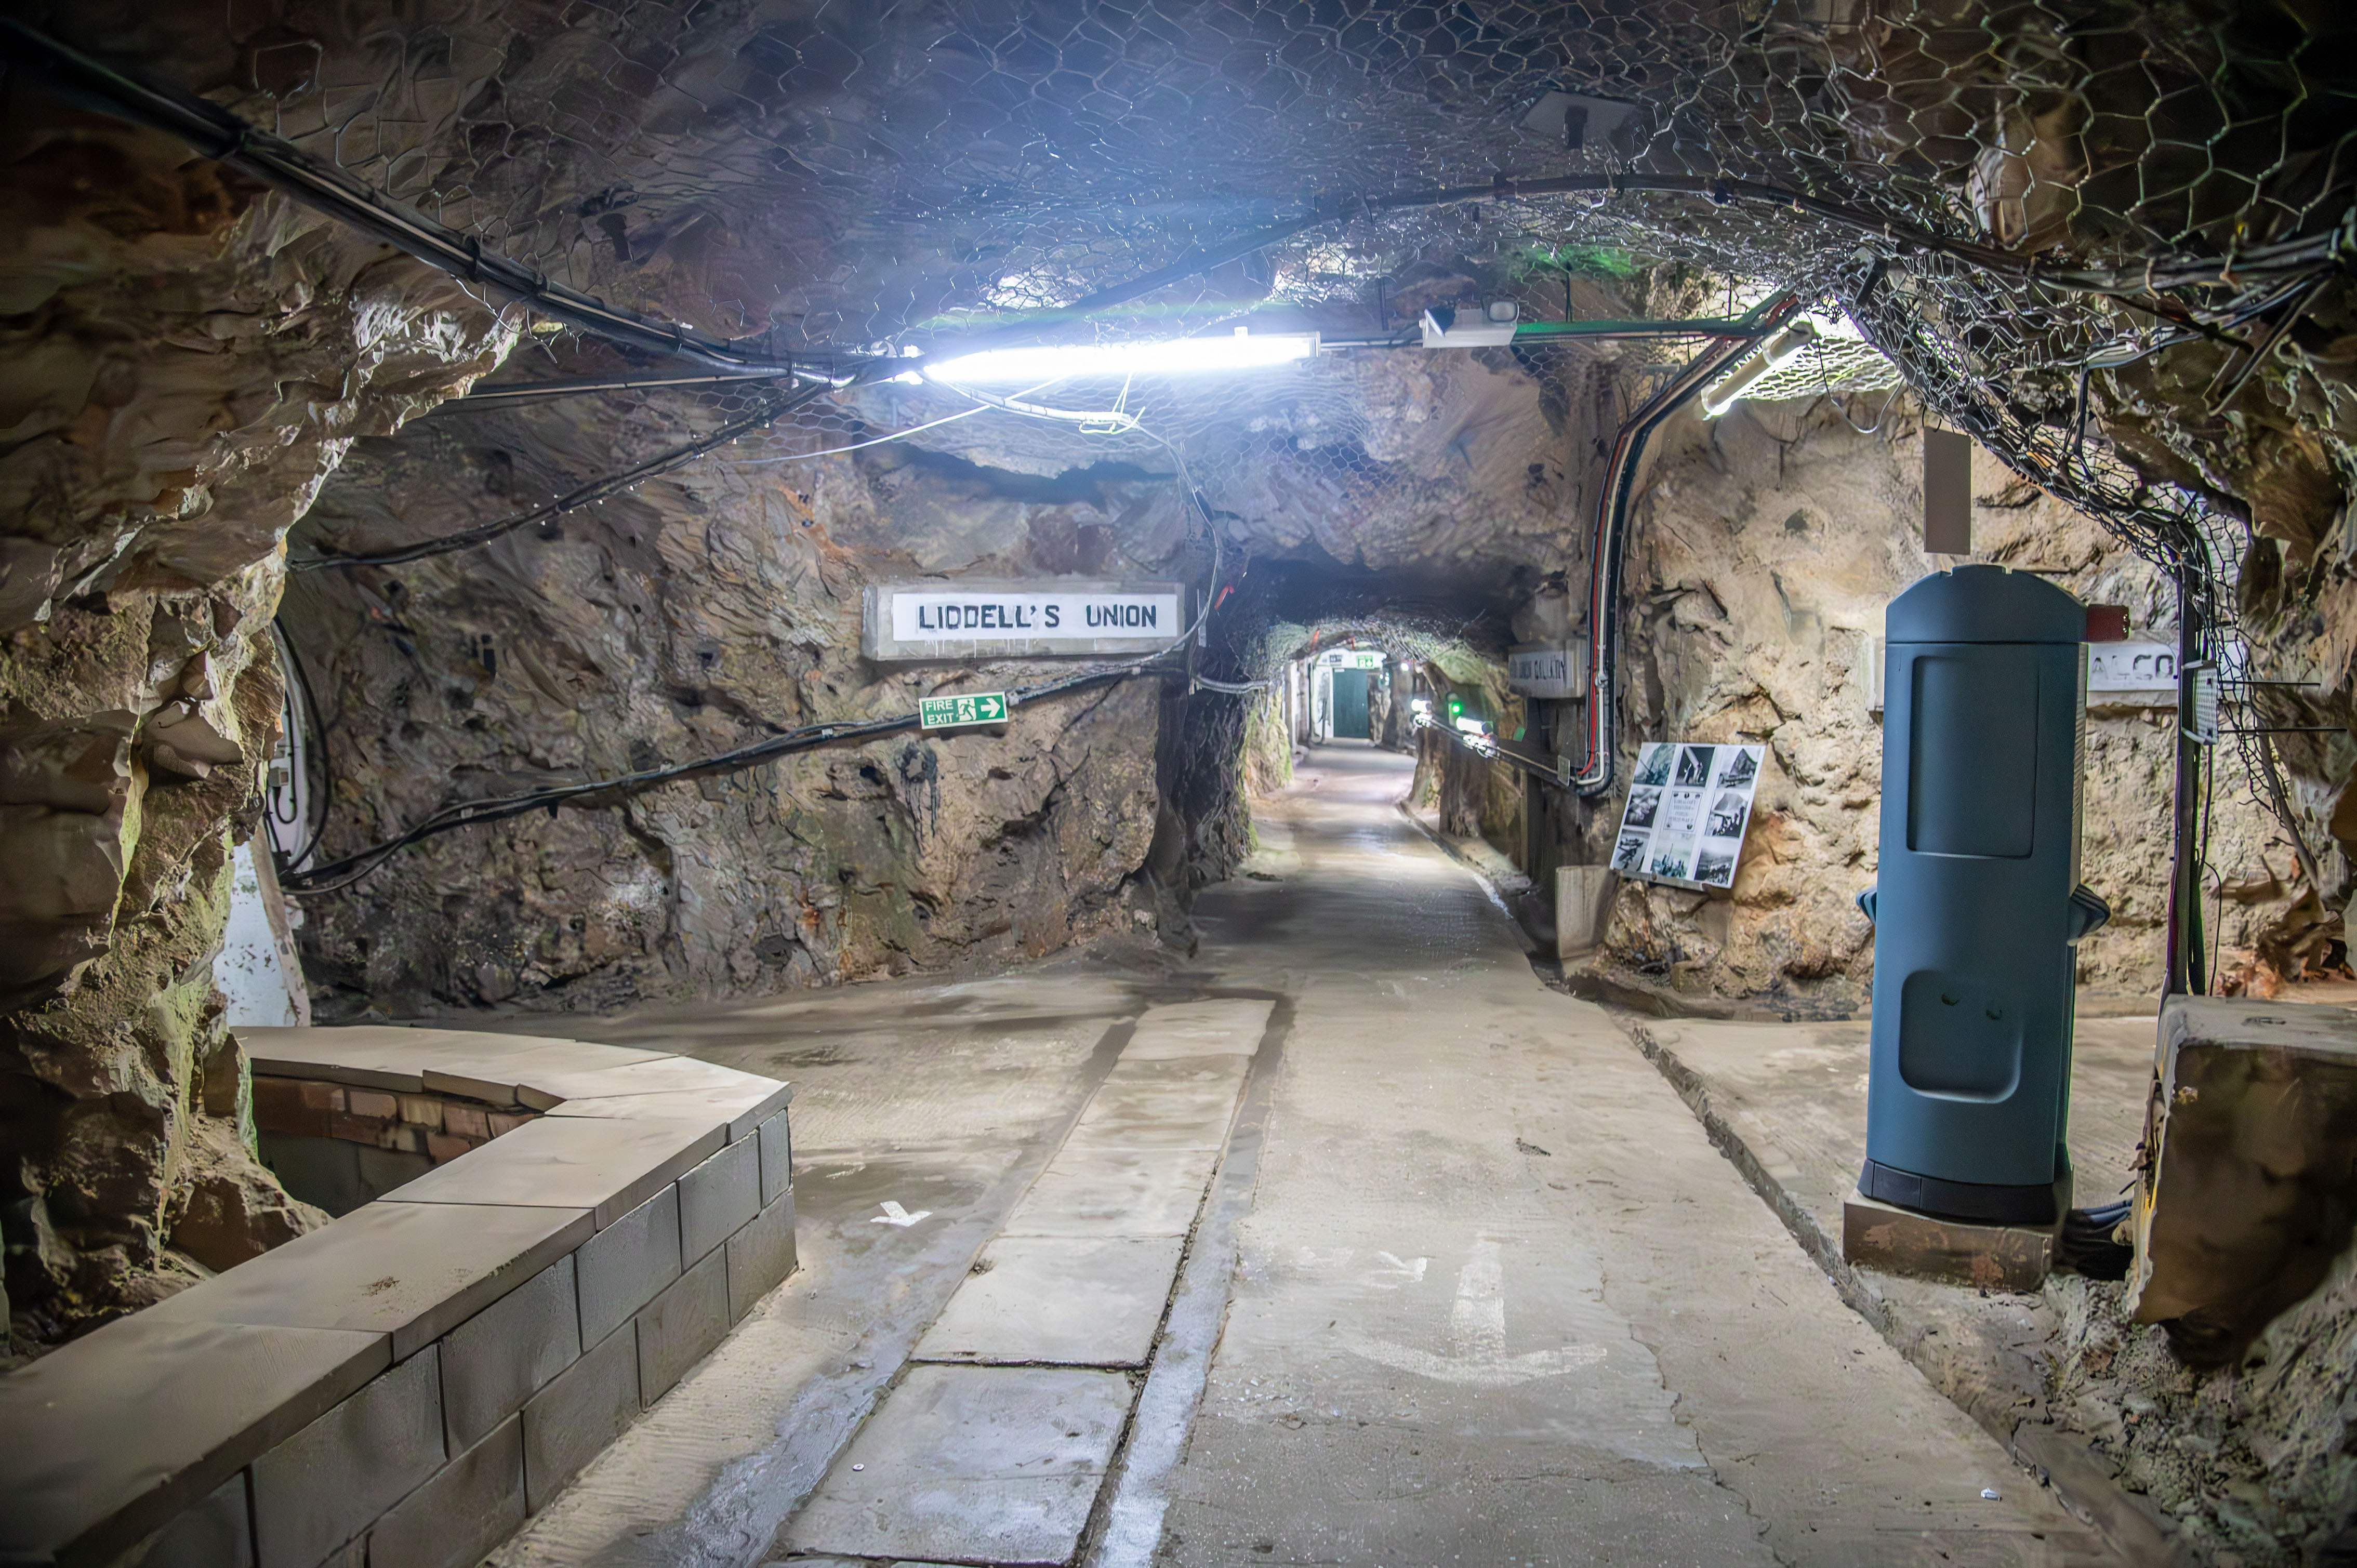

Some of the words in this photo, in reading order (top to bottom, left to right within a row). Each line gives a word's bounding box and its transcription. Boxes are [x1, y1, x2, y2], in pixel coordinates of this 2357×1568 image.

[919, 604, 1060, 629] LIDDELL'S
[1086, 604, 1157, 629] UNION
[2091, 654, 2175, 680] ALCO
[925, 699, 954, 712] FIRE
[926, 712, 955, 725] EXIT
